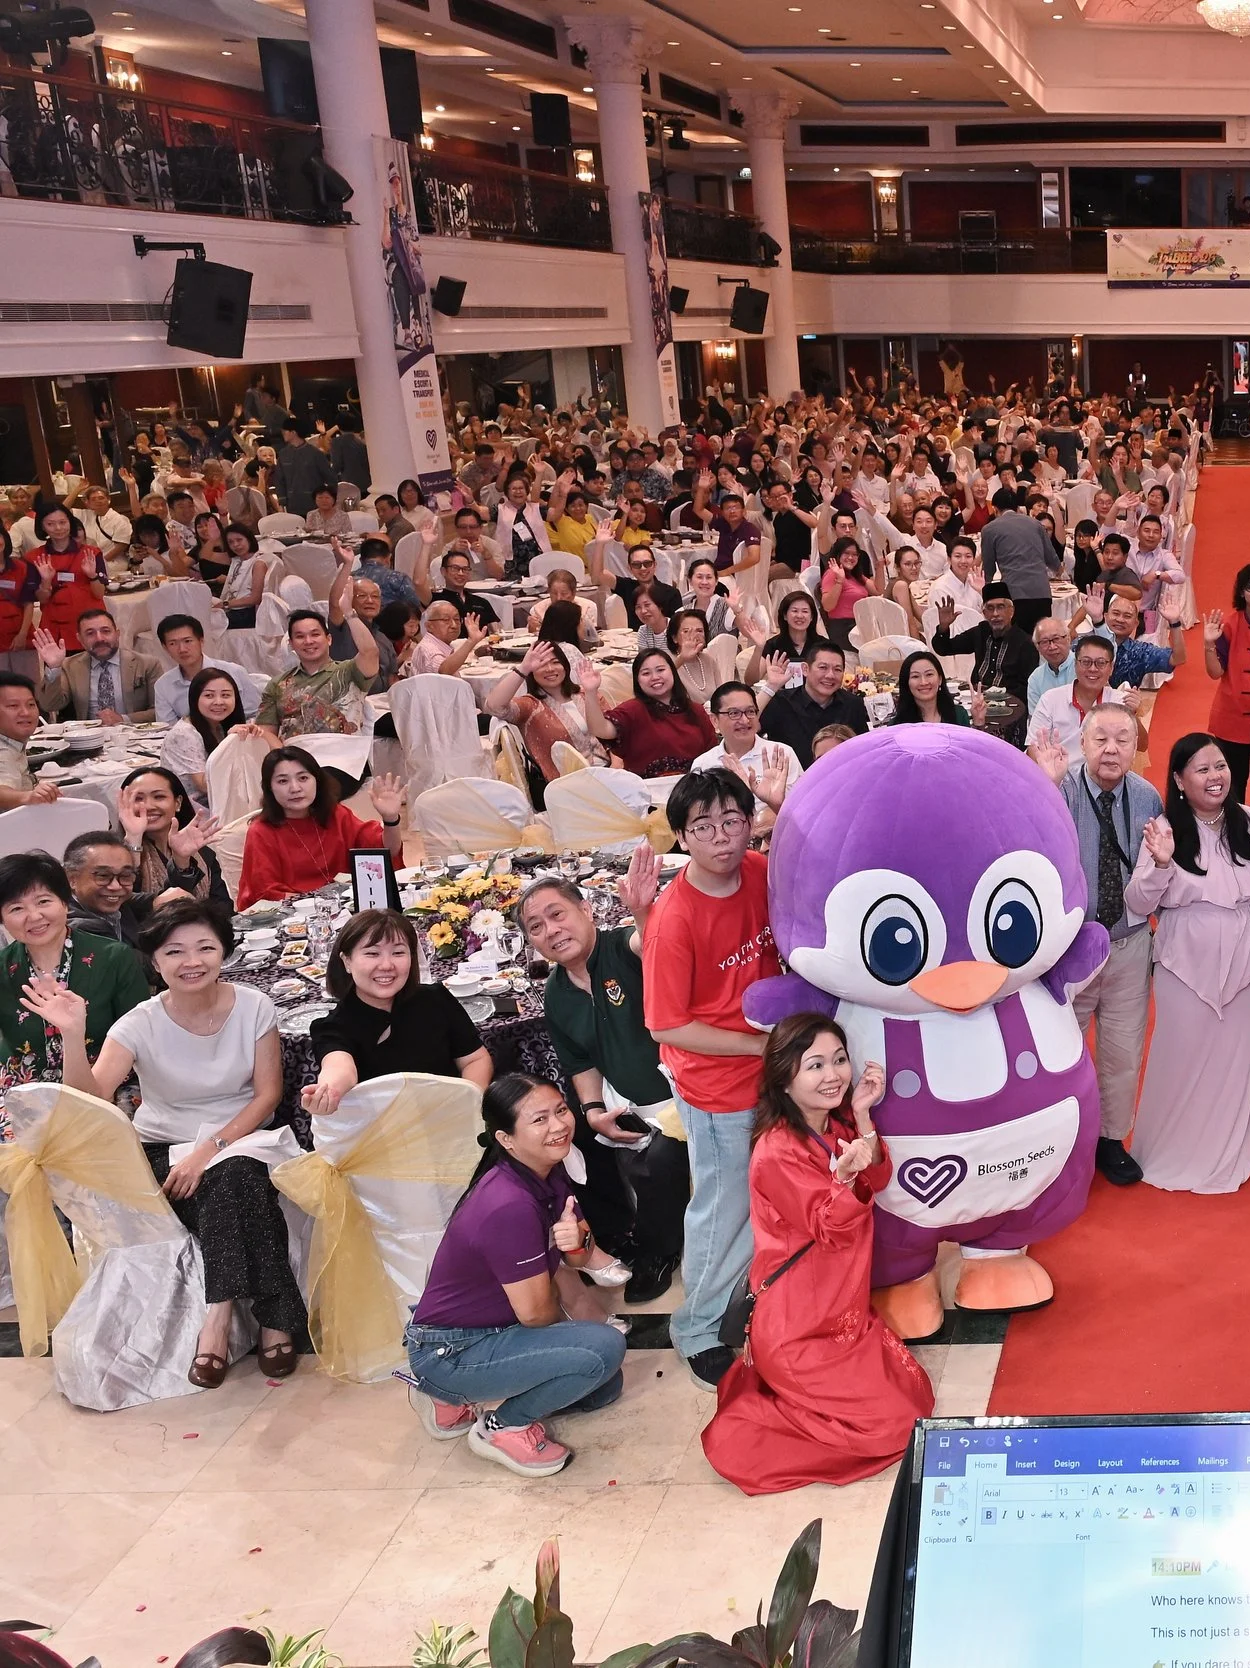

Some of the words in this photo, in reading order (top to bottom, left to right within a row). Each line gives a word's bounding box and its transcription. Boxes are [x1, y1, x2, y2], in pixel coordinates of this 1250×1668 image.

[977, 1157, 1025, 1176] Blossom
[1027, 1145, 1055, 1164] Seeds
[938, 1461, 951, 1470] File
[974, 1461, 998, 1469] Home
[1015, 1460, 1037, 1468] Insert
[1054, 1459, 1080, 1469] Design
[1098, 1459, 1123, 1469] Layout
[1140, 1457, 1180, 1466] References
[1197, 1456, 1229, 1467] Mailings
[984, 1489, 1001, 1497] Arial
[1059, 1488, 1069, 1496] 13
[931, 1509, 951, 1517] Paste
[924, 1536, 957, 1544] Clipboard
[1075, 1533, 1091, 1541] Font
[1151, 1595, 1177, 1606] Who
[1180, 1595, 1204, 1605] here
[1208, 1594, 1243, 1605] knows
[1150, 1626, 1174, 1638] This
[1177, 1627, 1187, 1638] is
[1190, 1627, 1208, 1637] not
[1210, 1626, 1230, 1640] just
[1233, 1628, 1240, 1636] a
[1171, 1659, 1178, 1668] If
[1204, 1659, 1230, 1668] dare
[1233, 1660, 1244, 1668] to
